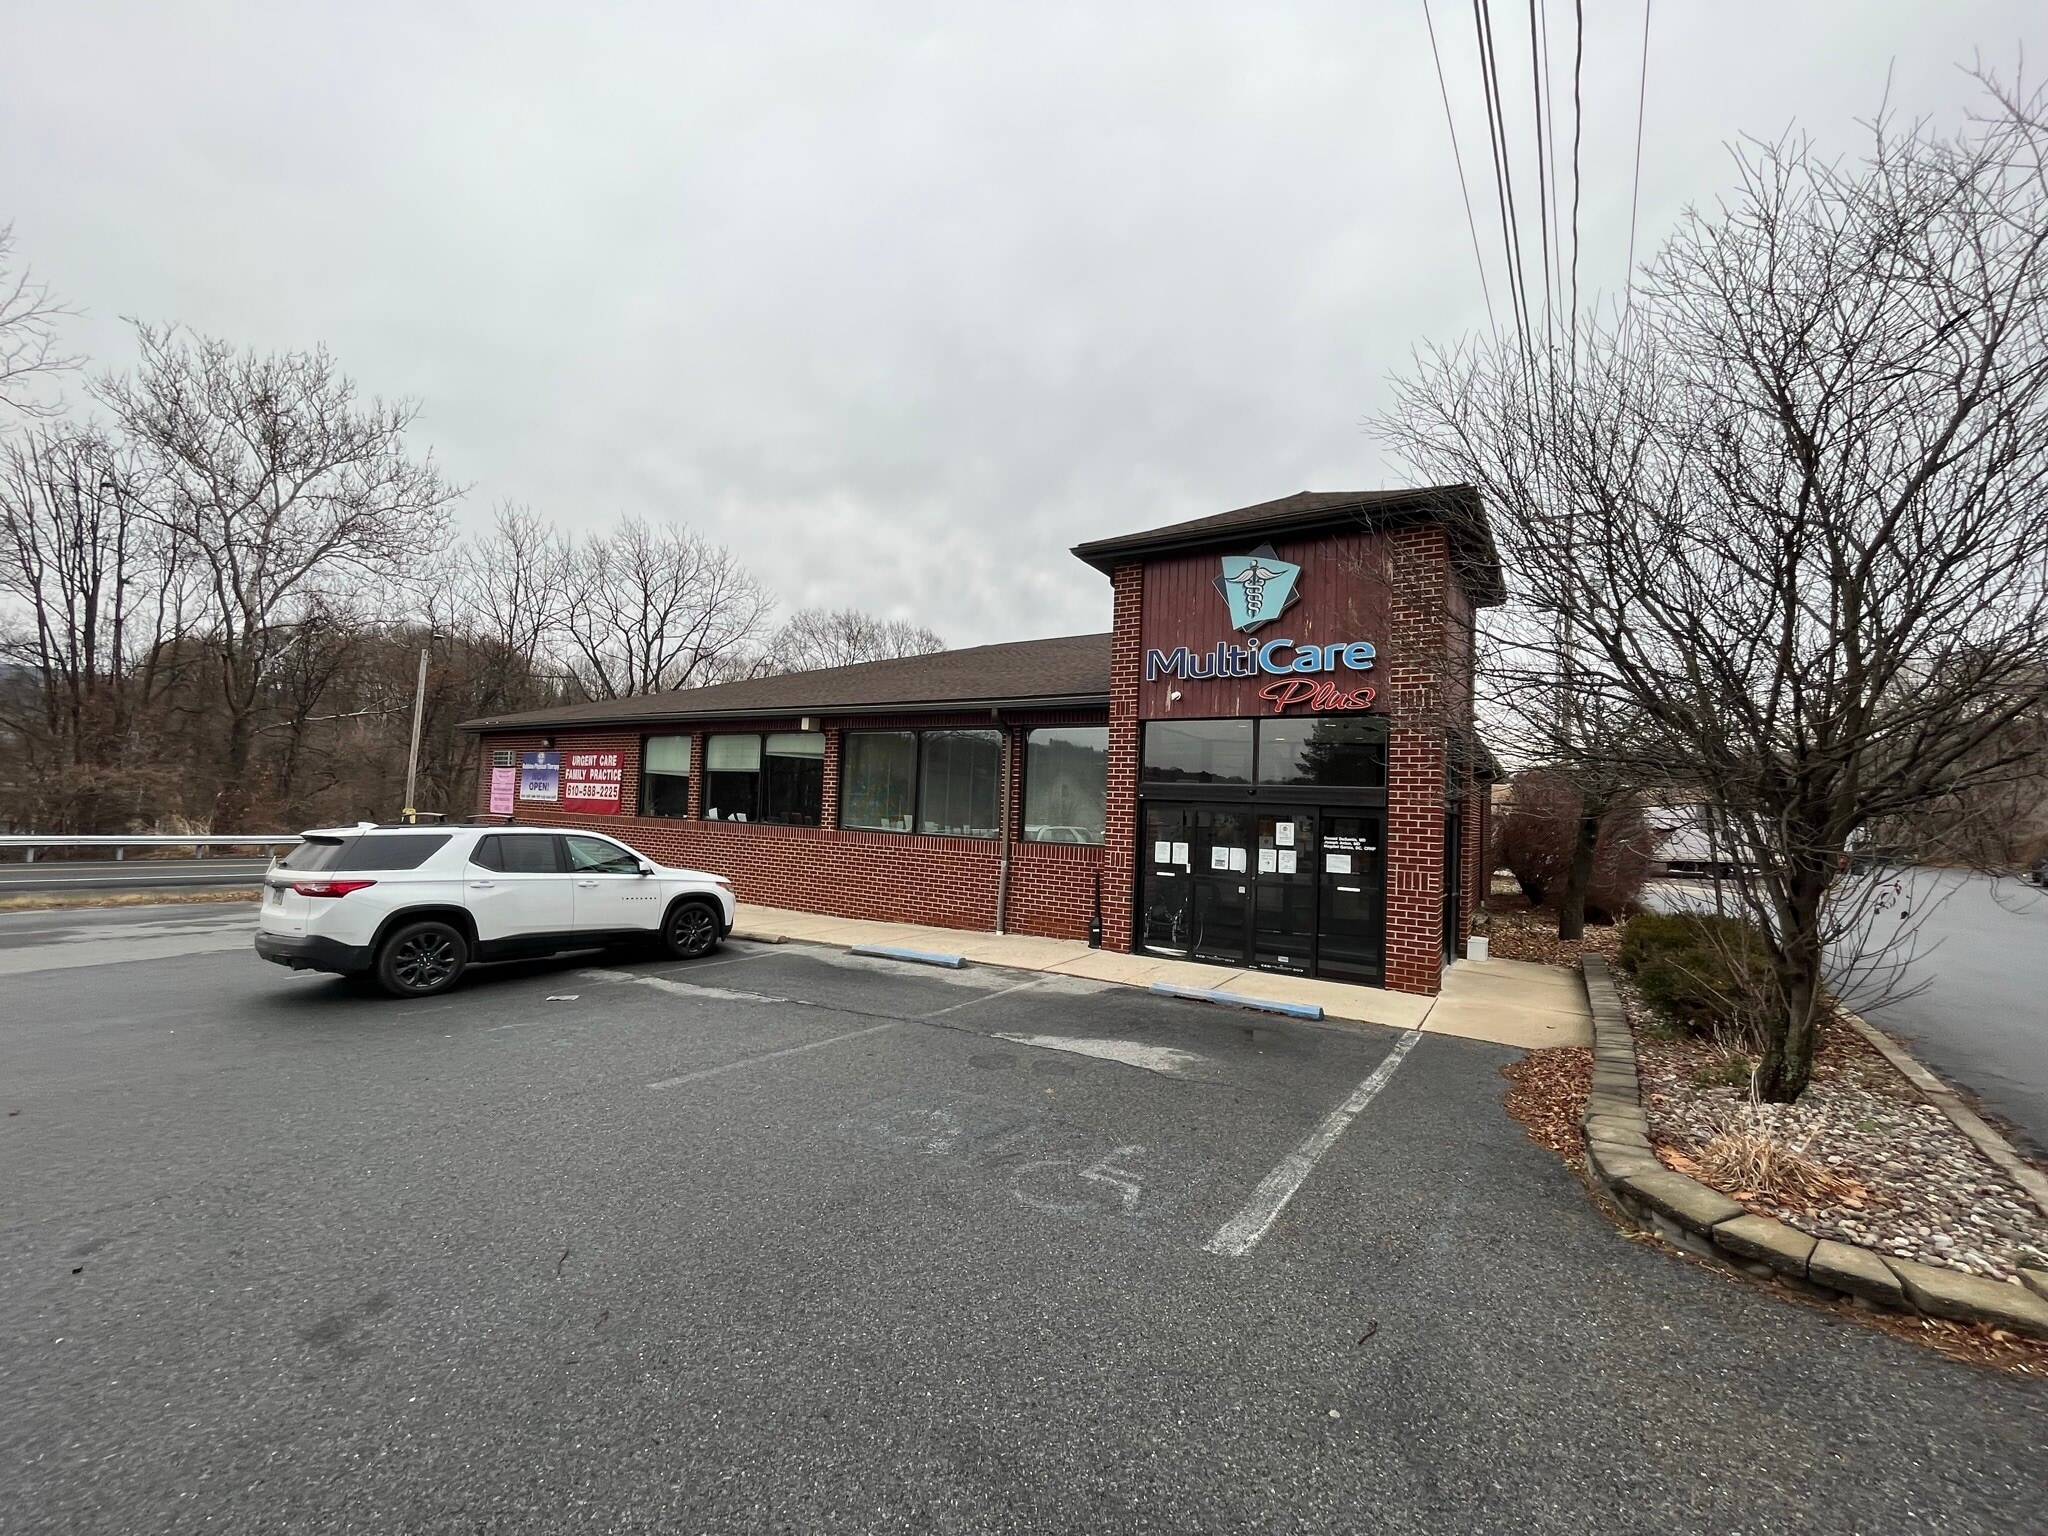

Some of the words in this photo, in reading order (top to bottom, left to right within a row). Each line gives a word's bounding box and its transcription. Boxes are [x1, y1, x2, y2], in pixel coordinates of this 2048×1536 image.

[1146, 638, 1376, 681] MultiCare
[1259, 677, 1376, 713] Plus
[572, 754, 597, 766] URGENT
[600, 754, 617, 766] CARE
[565, 768, 586, 780] FAMILY
[590, 768, 622, 780] PRACTICE
